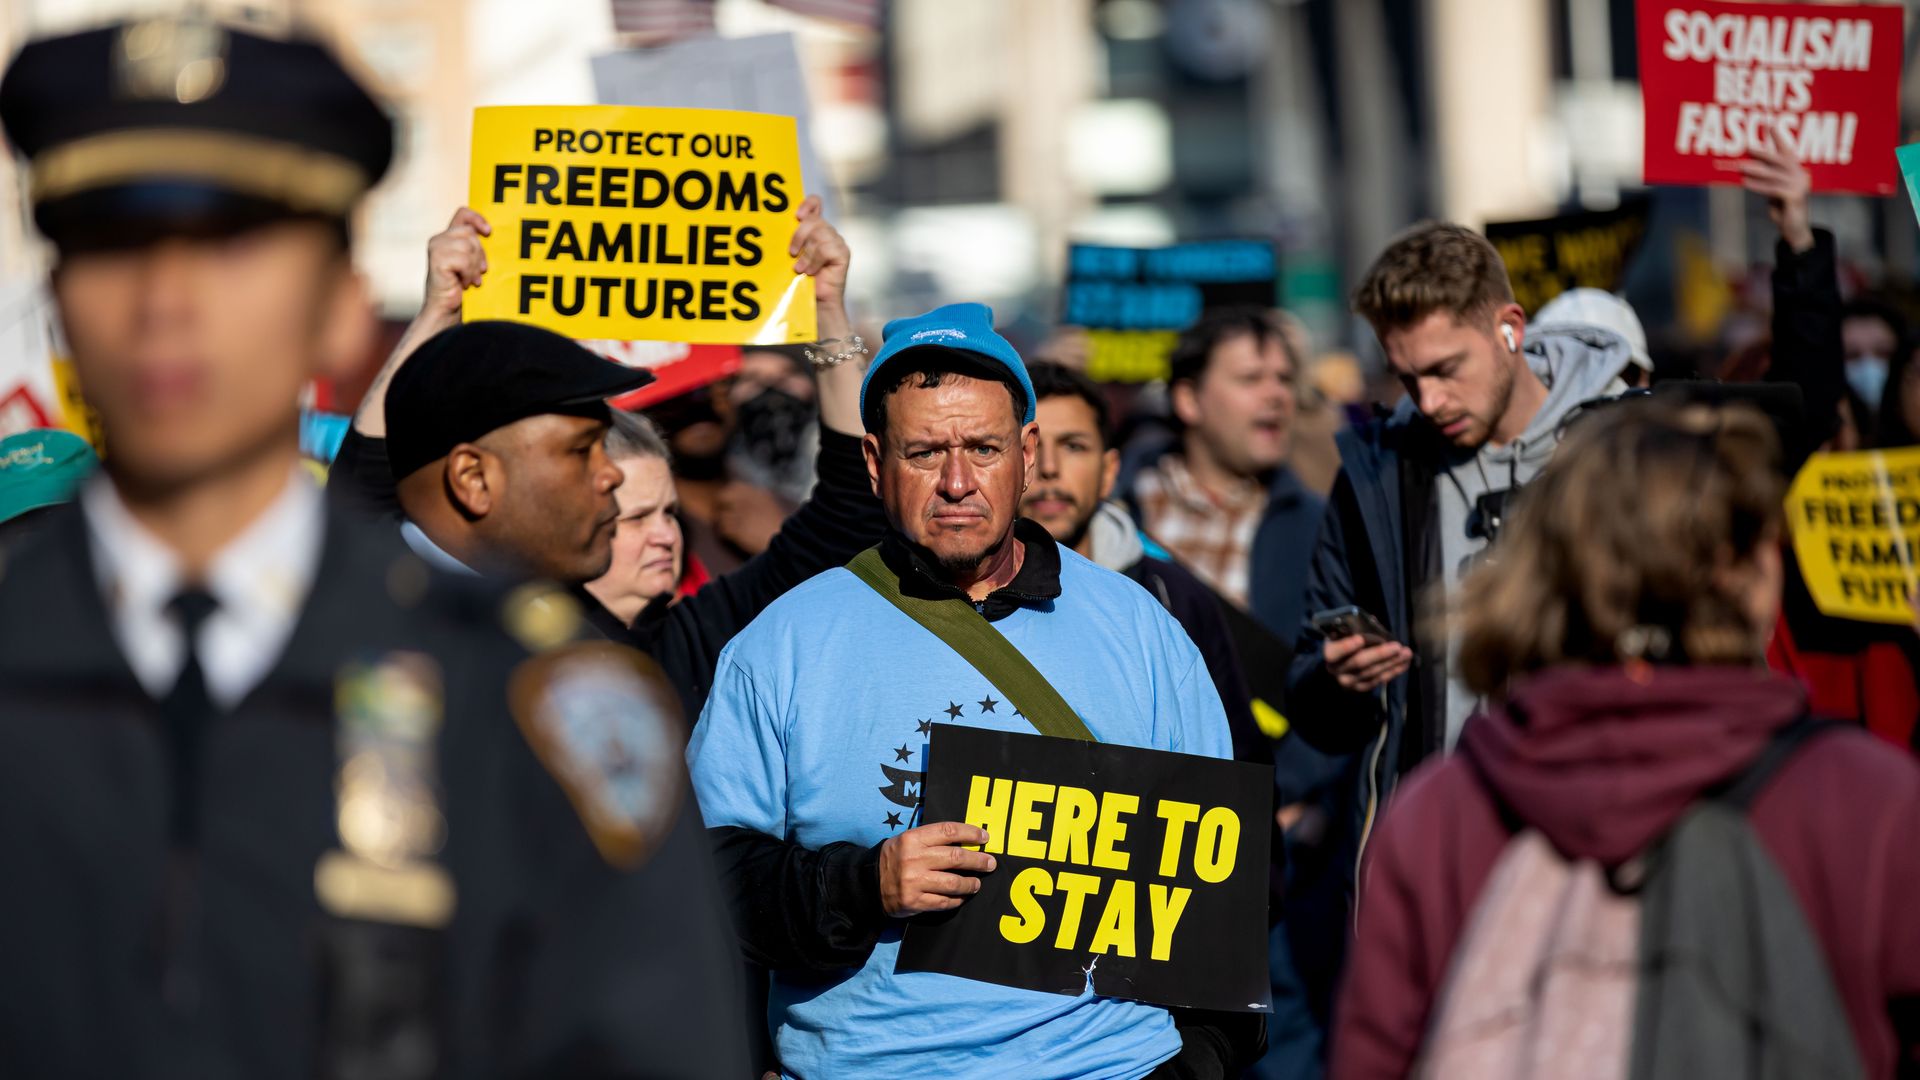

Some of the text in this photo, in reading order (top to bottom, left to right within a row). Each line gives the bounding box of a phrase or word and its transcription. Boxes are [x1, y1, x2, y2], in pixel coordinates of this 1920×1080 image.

[1664, 9, 1872, 71] SOCIALISM
[1714, 64, 1813, 111] BEATS
[534, 129, 754, 158] PROTECT OUR
[493, 165, 788, 212] FREEDOMS
[520, 220, 762, 266] FAMILIES
[519, 275, 760, 321] FUTURES
[961, 775, 1240, 883] HERE TO
[999, 867, 1192, 961] STAY
